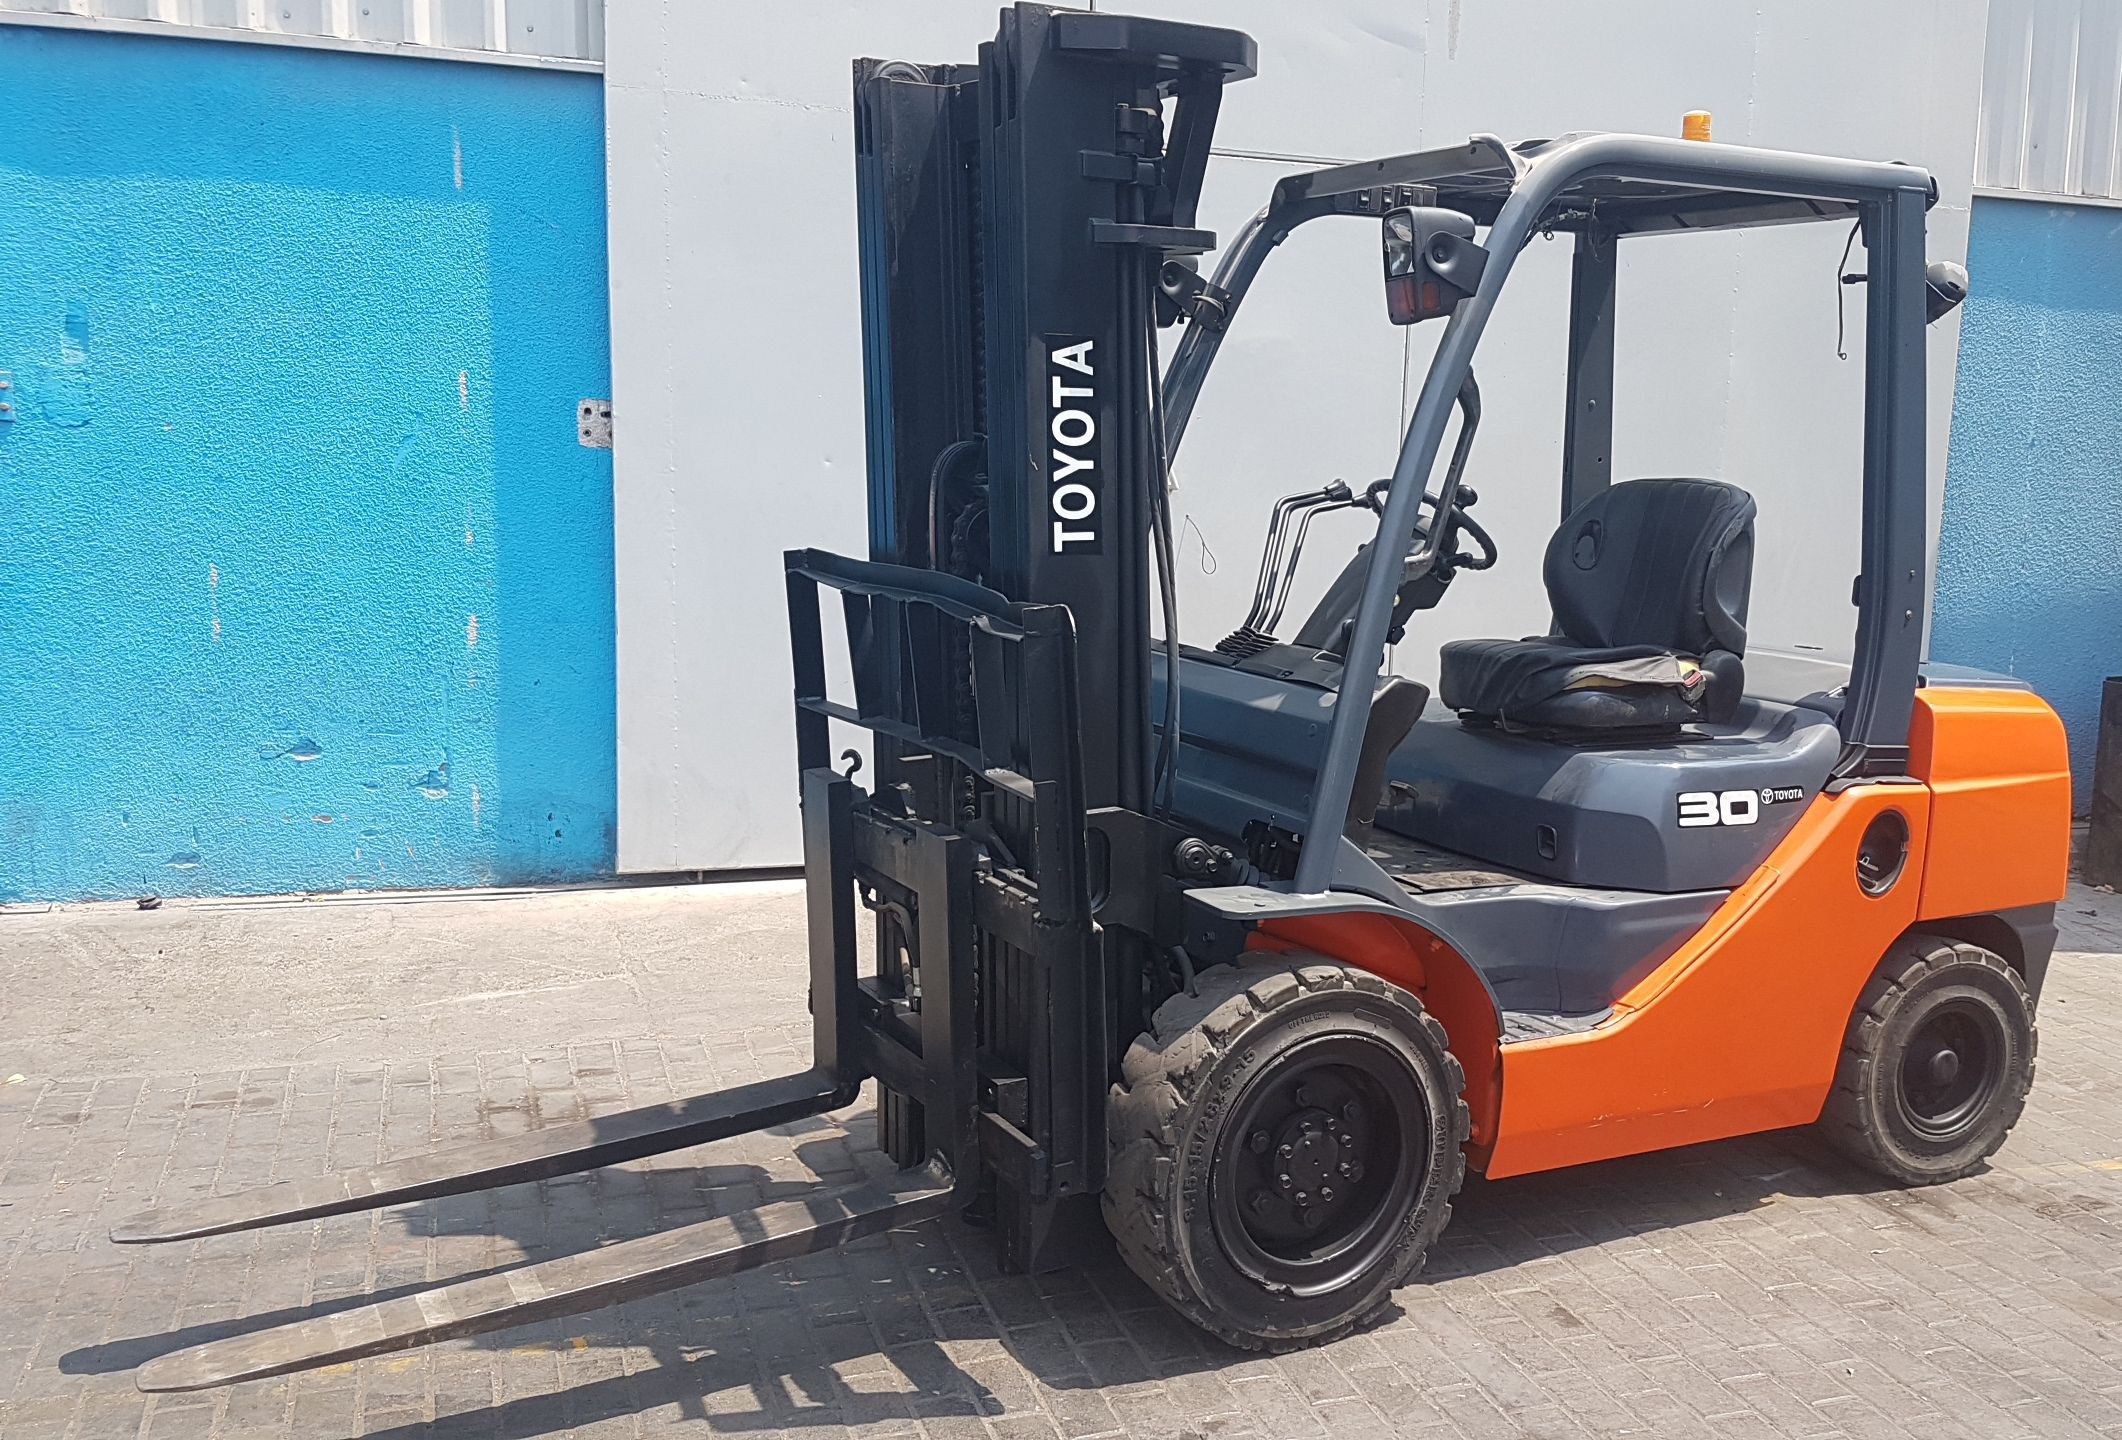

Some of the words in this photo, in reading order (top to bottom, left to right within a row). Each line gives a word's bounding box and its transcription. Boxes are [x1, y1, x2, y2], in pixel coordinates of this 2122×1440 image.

[1051, 340, 1096, 553] TOYOTA
[1678, 789, 1759, 827] 30
[1773, 788, 1804, 801] TOYOTA
